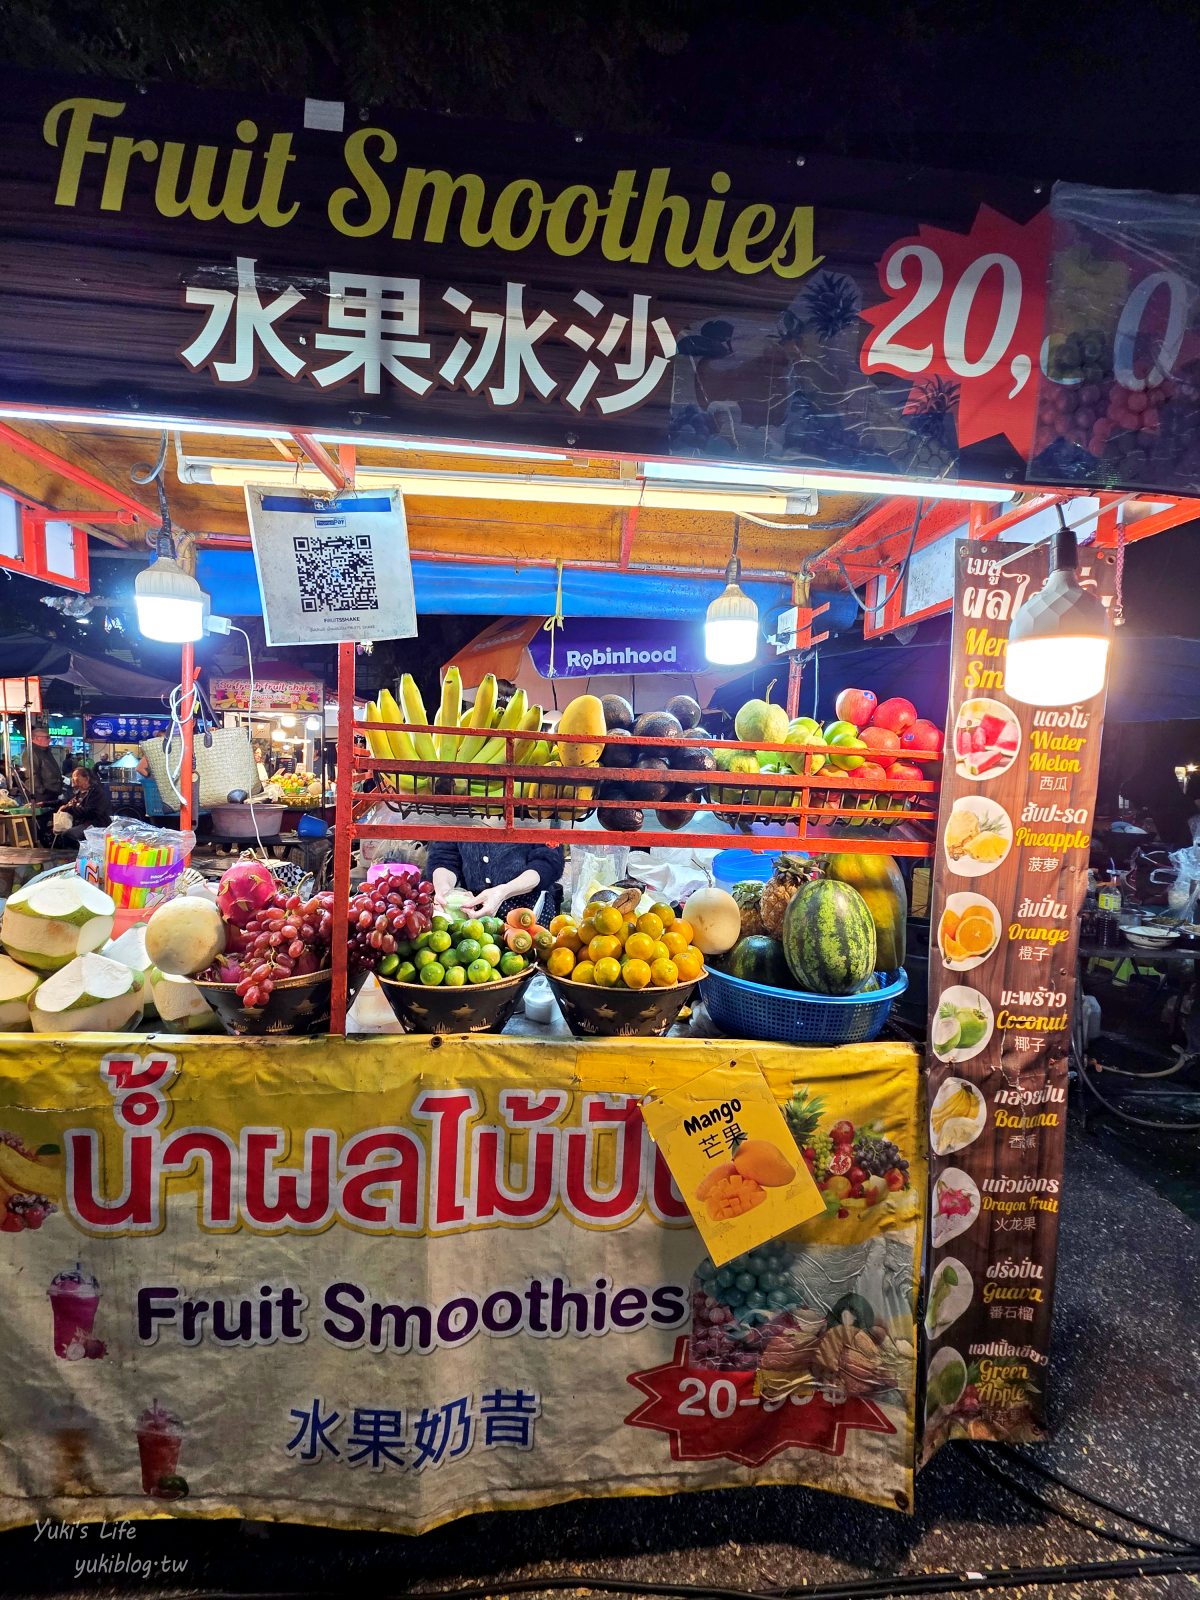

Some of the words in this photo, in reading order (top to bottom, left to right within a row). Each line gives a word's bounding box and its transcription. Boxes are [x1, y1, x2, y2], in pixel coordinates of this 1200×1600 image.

[43, 97, 299, 229] Fruit
[327, 127, 826, 279] Smoothies
[181, 256, 677, 414] 水果冰沙
[964, 627, 1009, 657] Men
[566, 645, 677, 670] Robinhood
[1029, 730, 1087, 752] Water
[1028, 751, 1082, 773] Melon
[1039, 776, 1068, 791] 西瓜
[1015, 826, 1090, 853] Pineapple
[1007, 923, 1070, 946] Orange
[1018, 945, 1050, 962] 橙子
[1014, 1036, 1046, 1053] 椰子
[683, 1098, 743, 1137] Mango
[993, 1109, 1060, 1129] Banana
[698, 1122, 749, 1159] 芒果
[981, 1195, 1027, 1216] Dragon
[1028, 1195, 1059, 1213] Fruit
[993, 1216, 1037, 1232] 火龙果
[982, 1282, 1044, 1304] Guava
[137, 1285, 304, 1345] Fruit
[323, 1276, 686, 1350] Smoothies
[989, 1305, 1035, 1322] 番石榴
[979, 1359, 1030, 1381] Green
[976, 1380, 1026, 1408] Apple
[286, 1389, 537, 1471] 水果奶昔
